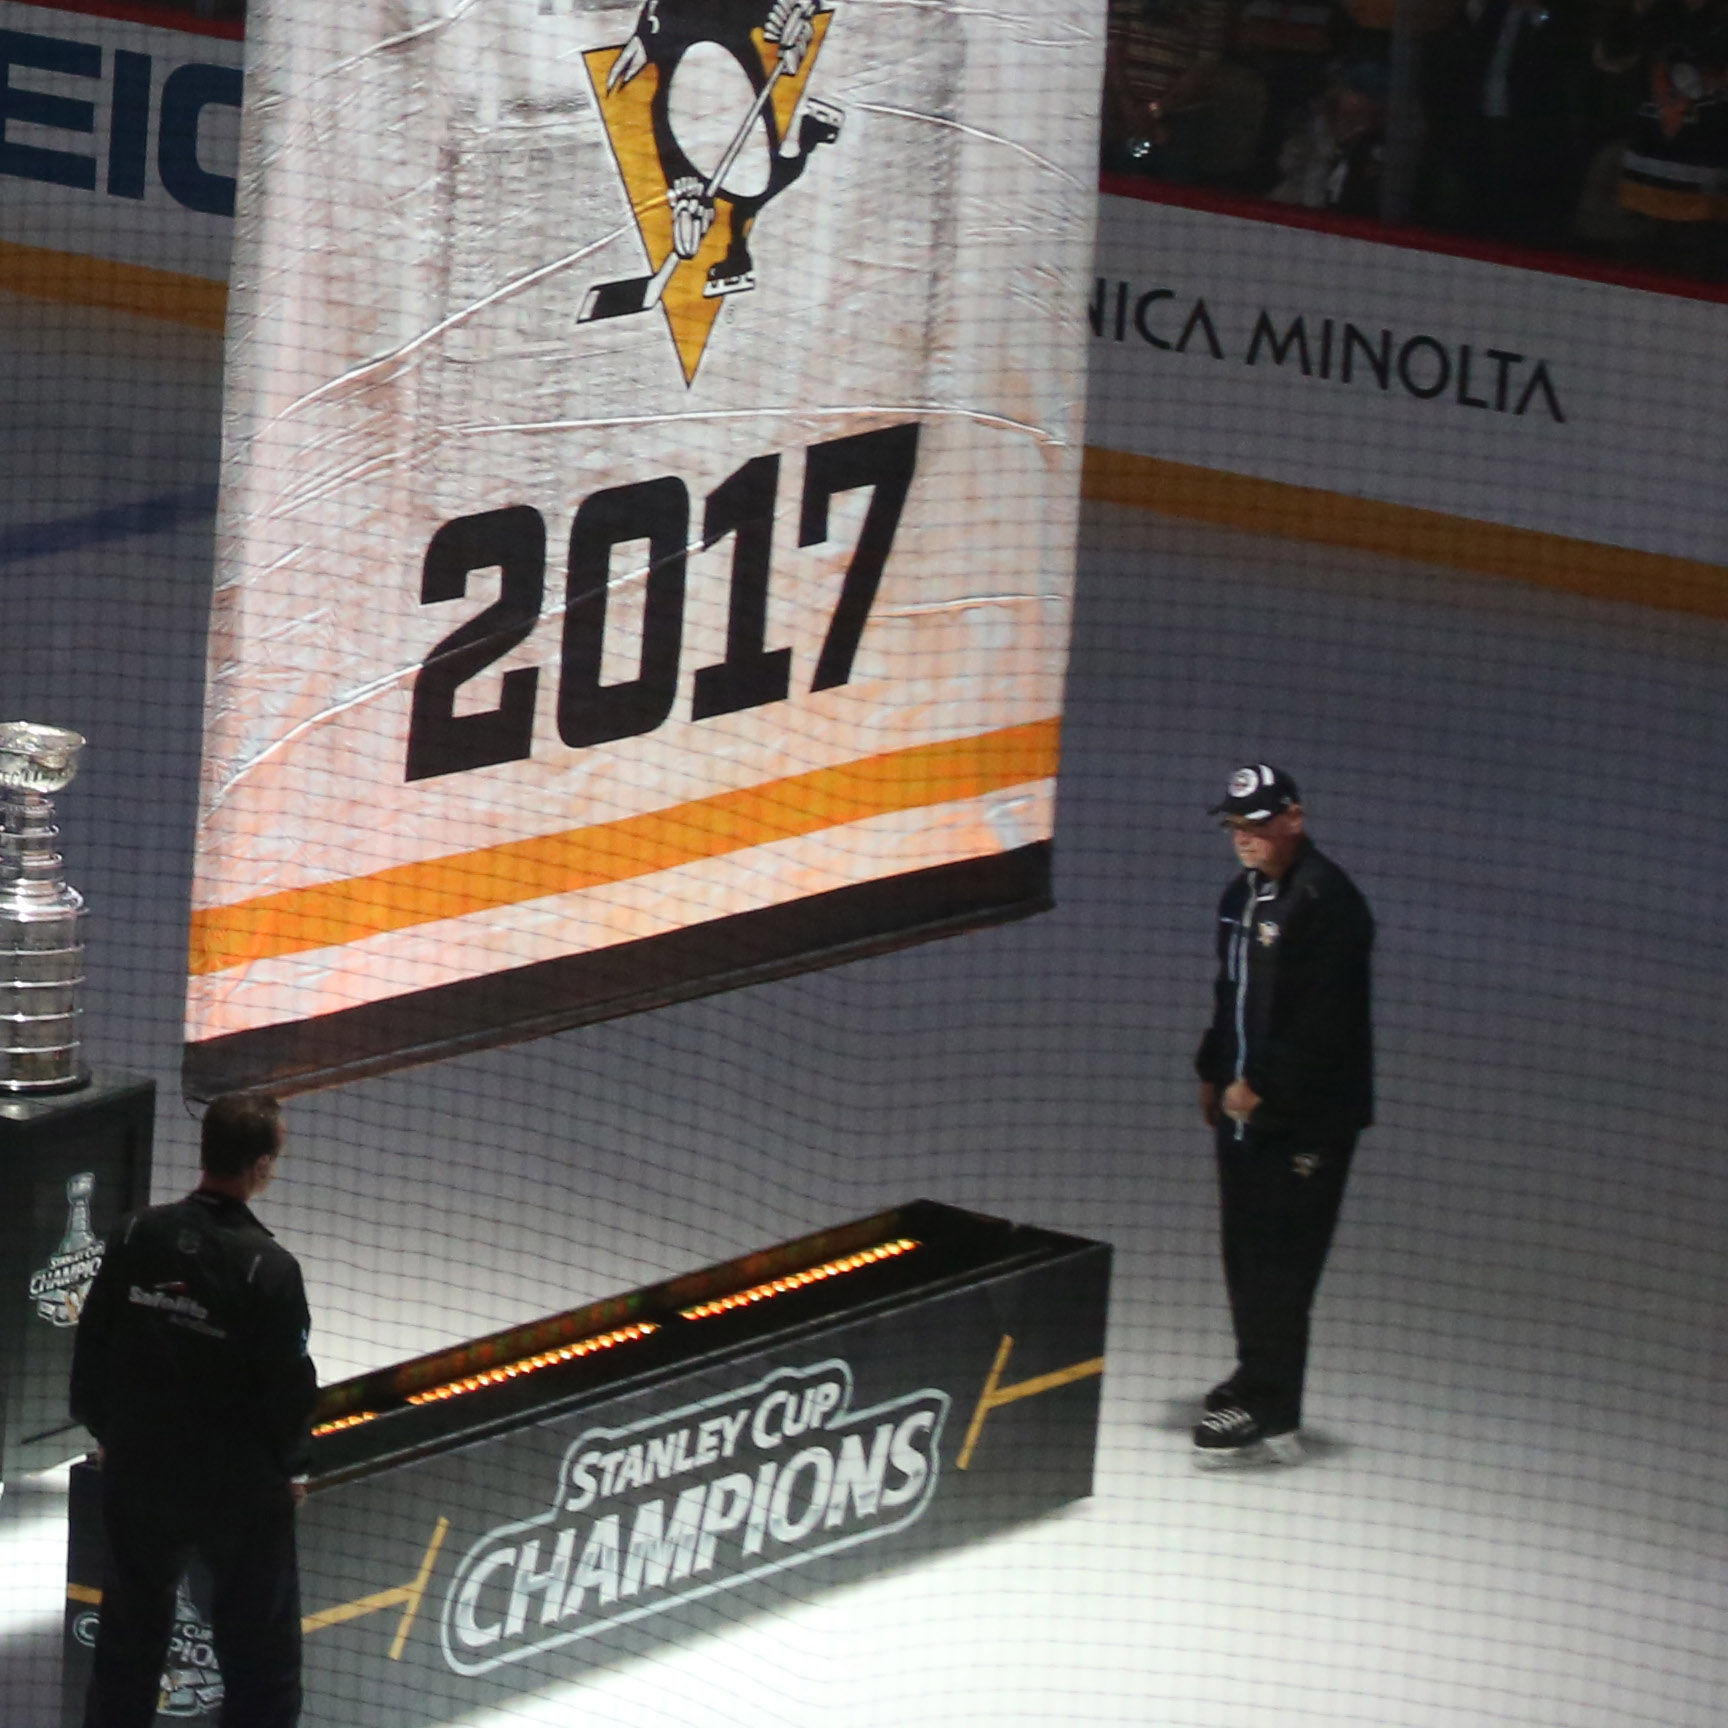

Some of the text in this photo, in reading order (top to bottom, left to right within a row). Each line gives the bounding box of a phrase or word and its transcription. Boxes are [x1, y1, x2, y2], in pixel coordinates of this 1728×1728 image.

[1247, 309, 1565, 423] MINOLTA
[403, 421, 921, 782] 2017
[454, 1409, 938, 1648] CHAMPIONS
[565, 1380, 841, 1512] STANLEY CUP
